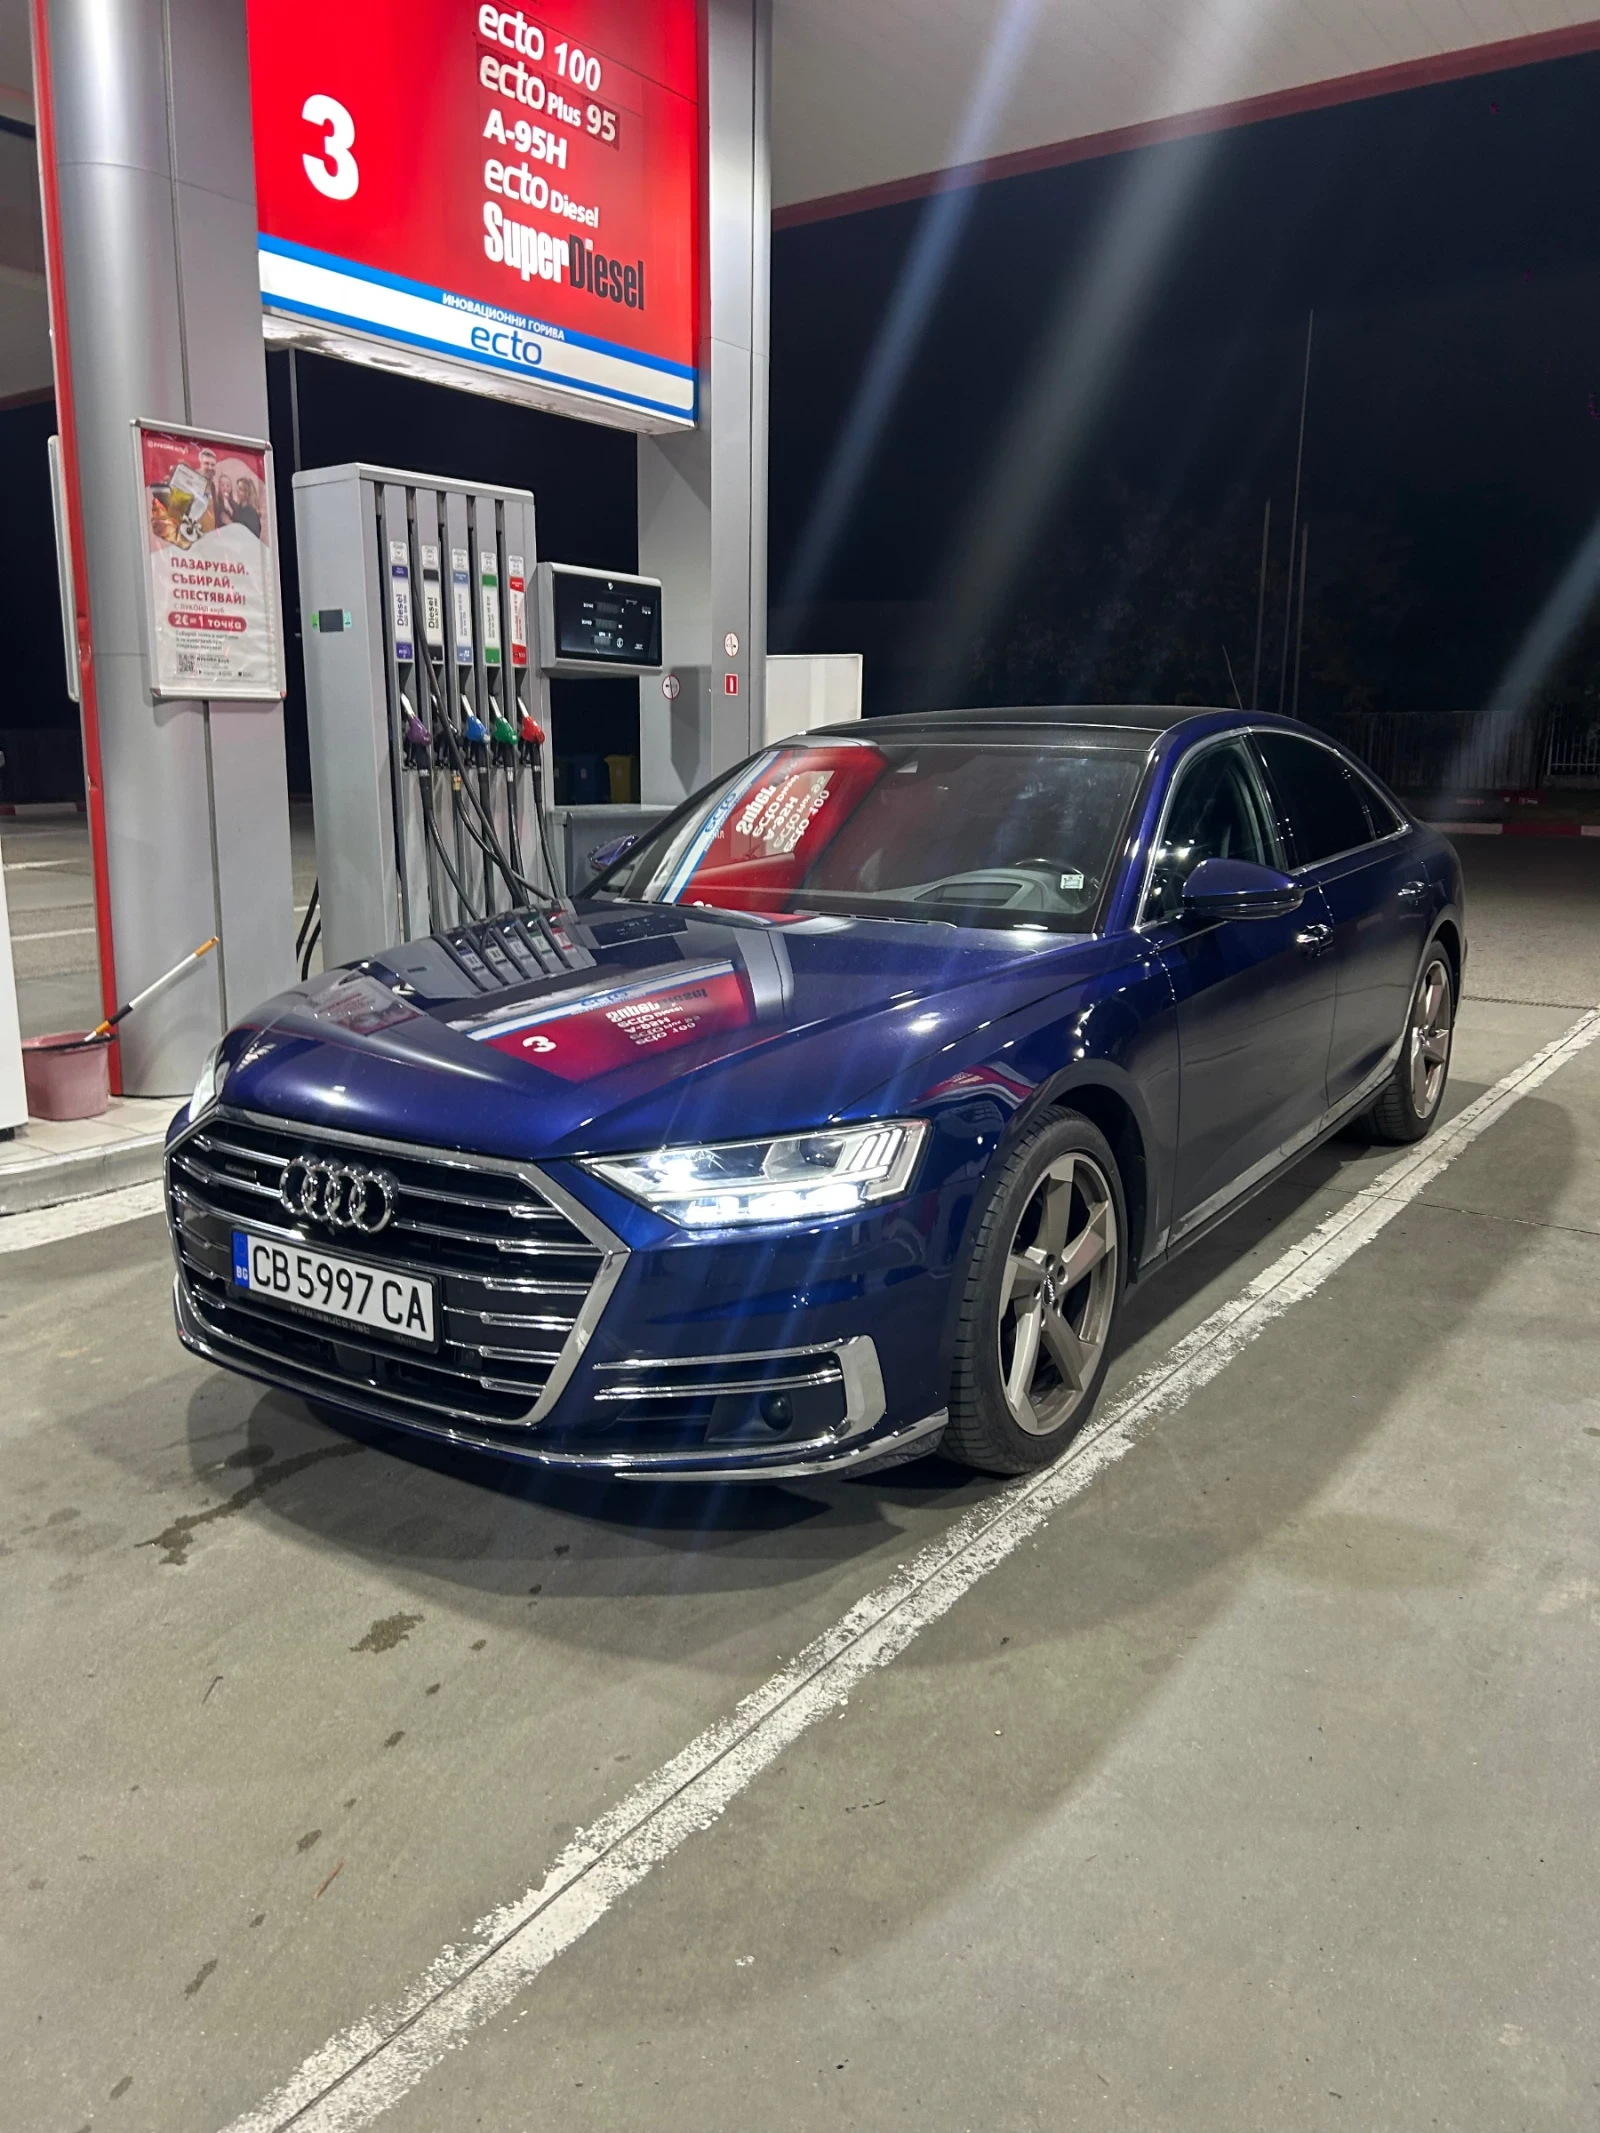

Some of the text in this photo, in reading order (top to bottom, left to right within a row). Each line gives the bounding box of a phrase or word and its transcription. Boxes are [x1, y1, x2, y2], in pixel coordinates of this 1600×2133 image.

[478, 3, 602, 92] ecto 100
[480, 55, 617, 142] ecto Plus 95
[301, 93, 360, 201] 3
[482, 108, 568, 169] A-95H
[484, 158, 599, 229] ecto Diesel
[442, 292, 565, 341] ИНОВАЦИОННИ ГОРИВА
[470, 325, 543, 365] ecto
[173, 588, 246, 605] СПЕСТЯВАЙ!
[396, 594, 404, 626] Diesel
[427, 597, 435, 629] Diesel
[207, 617, 242, 630] точка
[236, 1266, 249, 1281] BG
[297, 1255, 374, 1315] 5997
